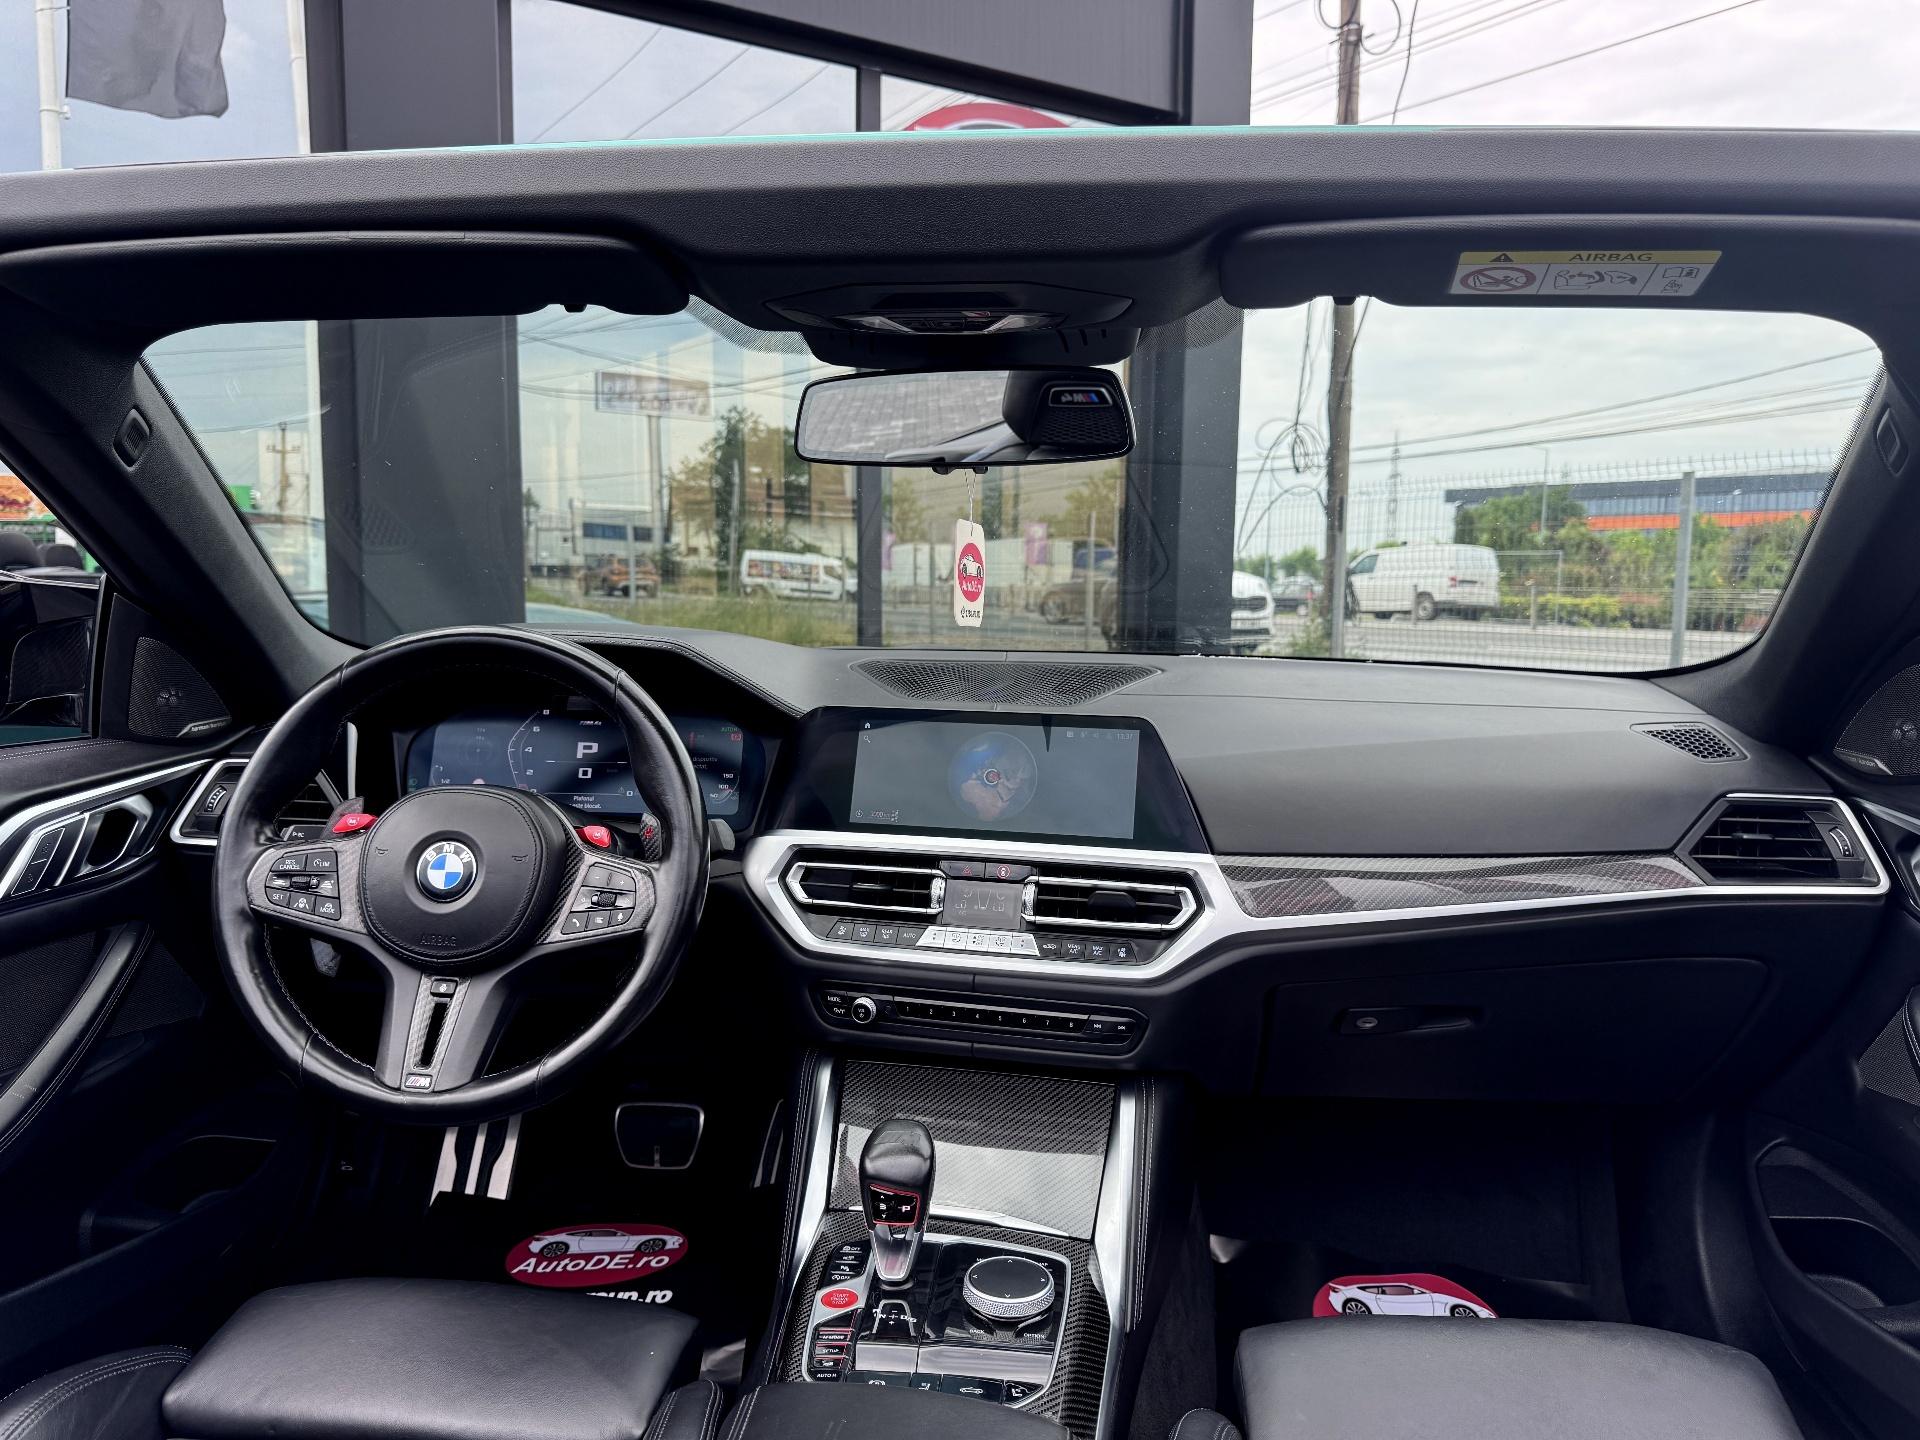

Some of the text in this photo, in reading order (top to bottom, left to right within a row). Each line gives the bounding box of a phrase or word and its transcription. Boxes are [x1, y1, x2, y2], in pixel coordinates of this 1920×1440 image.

[1568, 252, 1653, 262] AIRBAG
[576, 741, 599, 759] P
[578, 767, 593, 779] 0
[426, 843, 472, 863] BMW
[272, 893, 284, 901] SET
[902, 1205, 911, 1213] P
[511, 1253, 670, 1274] AutoDE.ro
